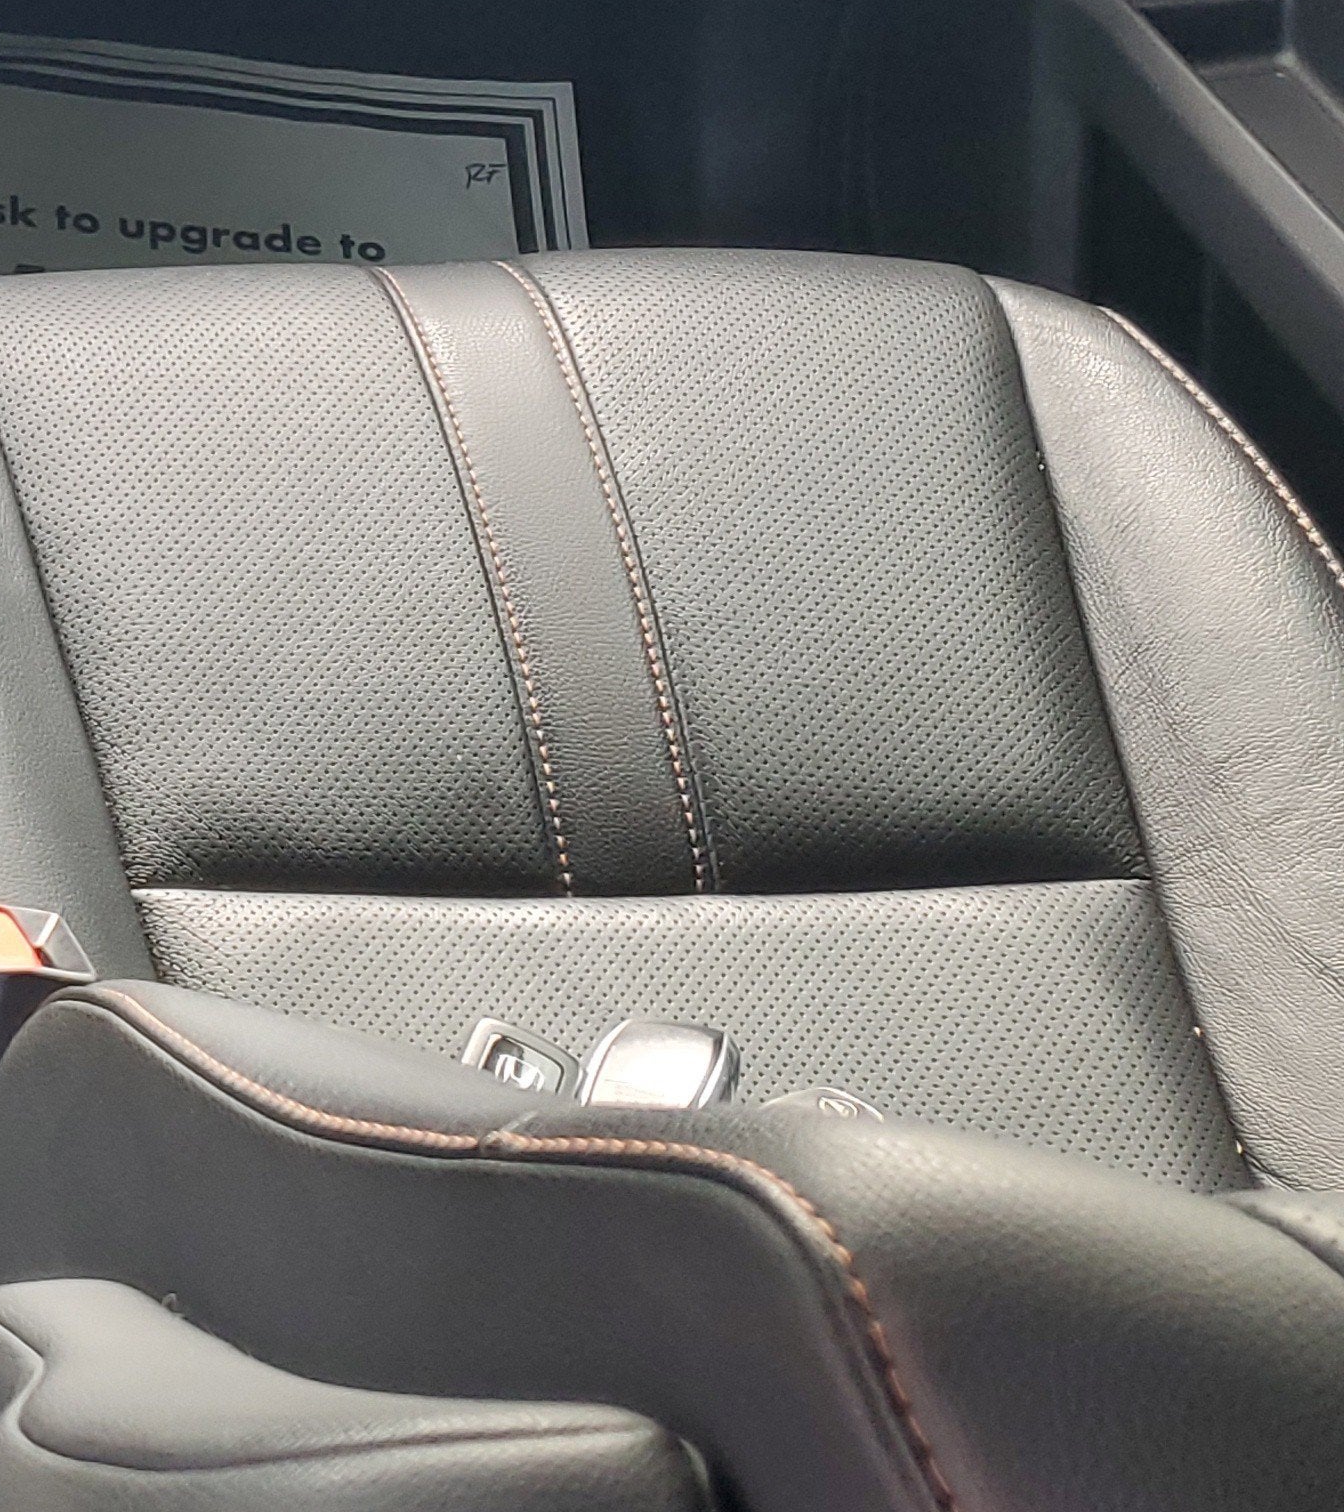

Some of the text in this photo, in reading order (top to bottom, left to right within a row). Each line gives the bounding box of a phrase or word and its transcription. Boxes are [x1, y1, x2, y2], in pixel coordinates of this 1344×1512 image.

[55, 204, 100, 234] to
[118, 216, 322, 255] upgrade
[339, 233, 387, 263] to
